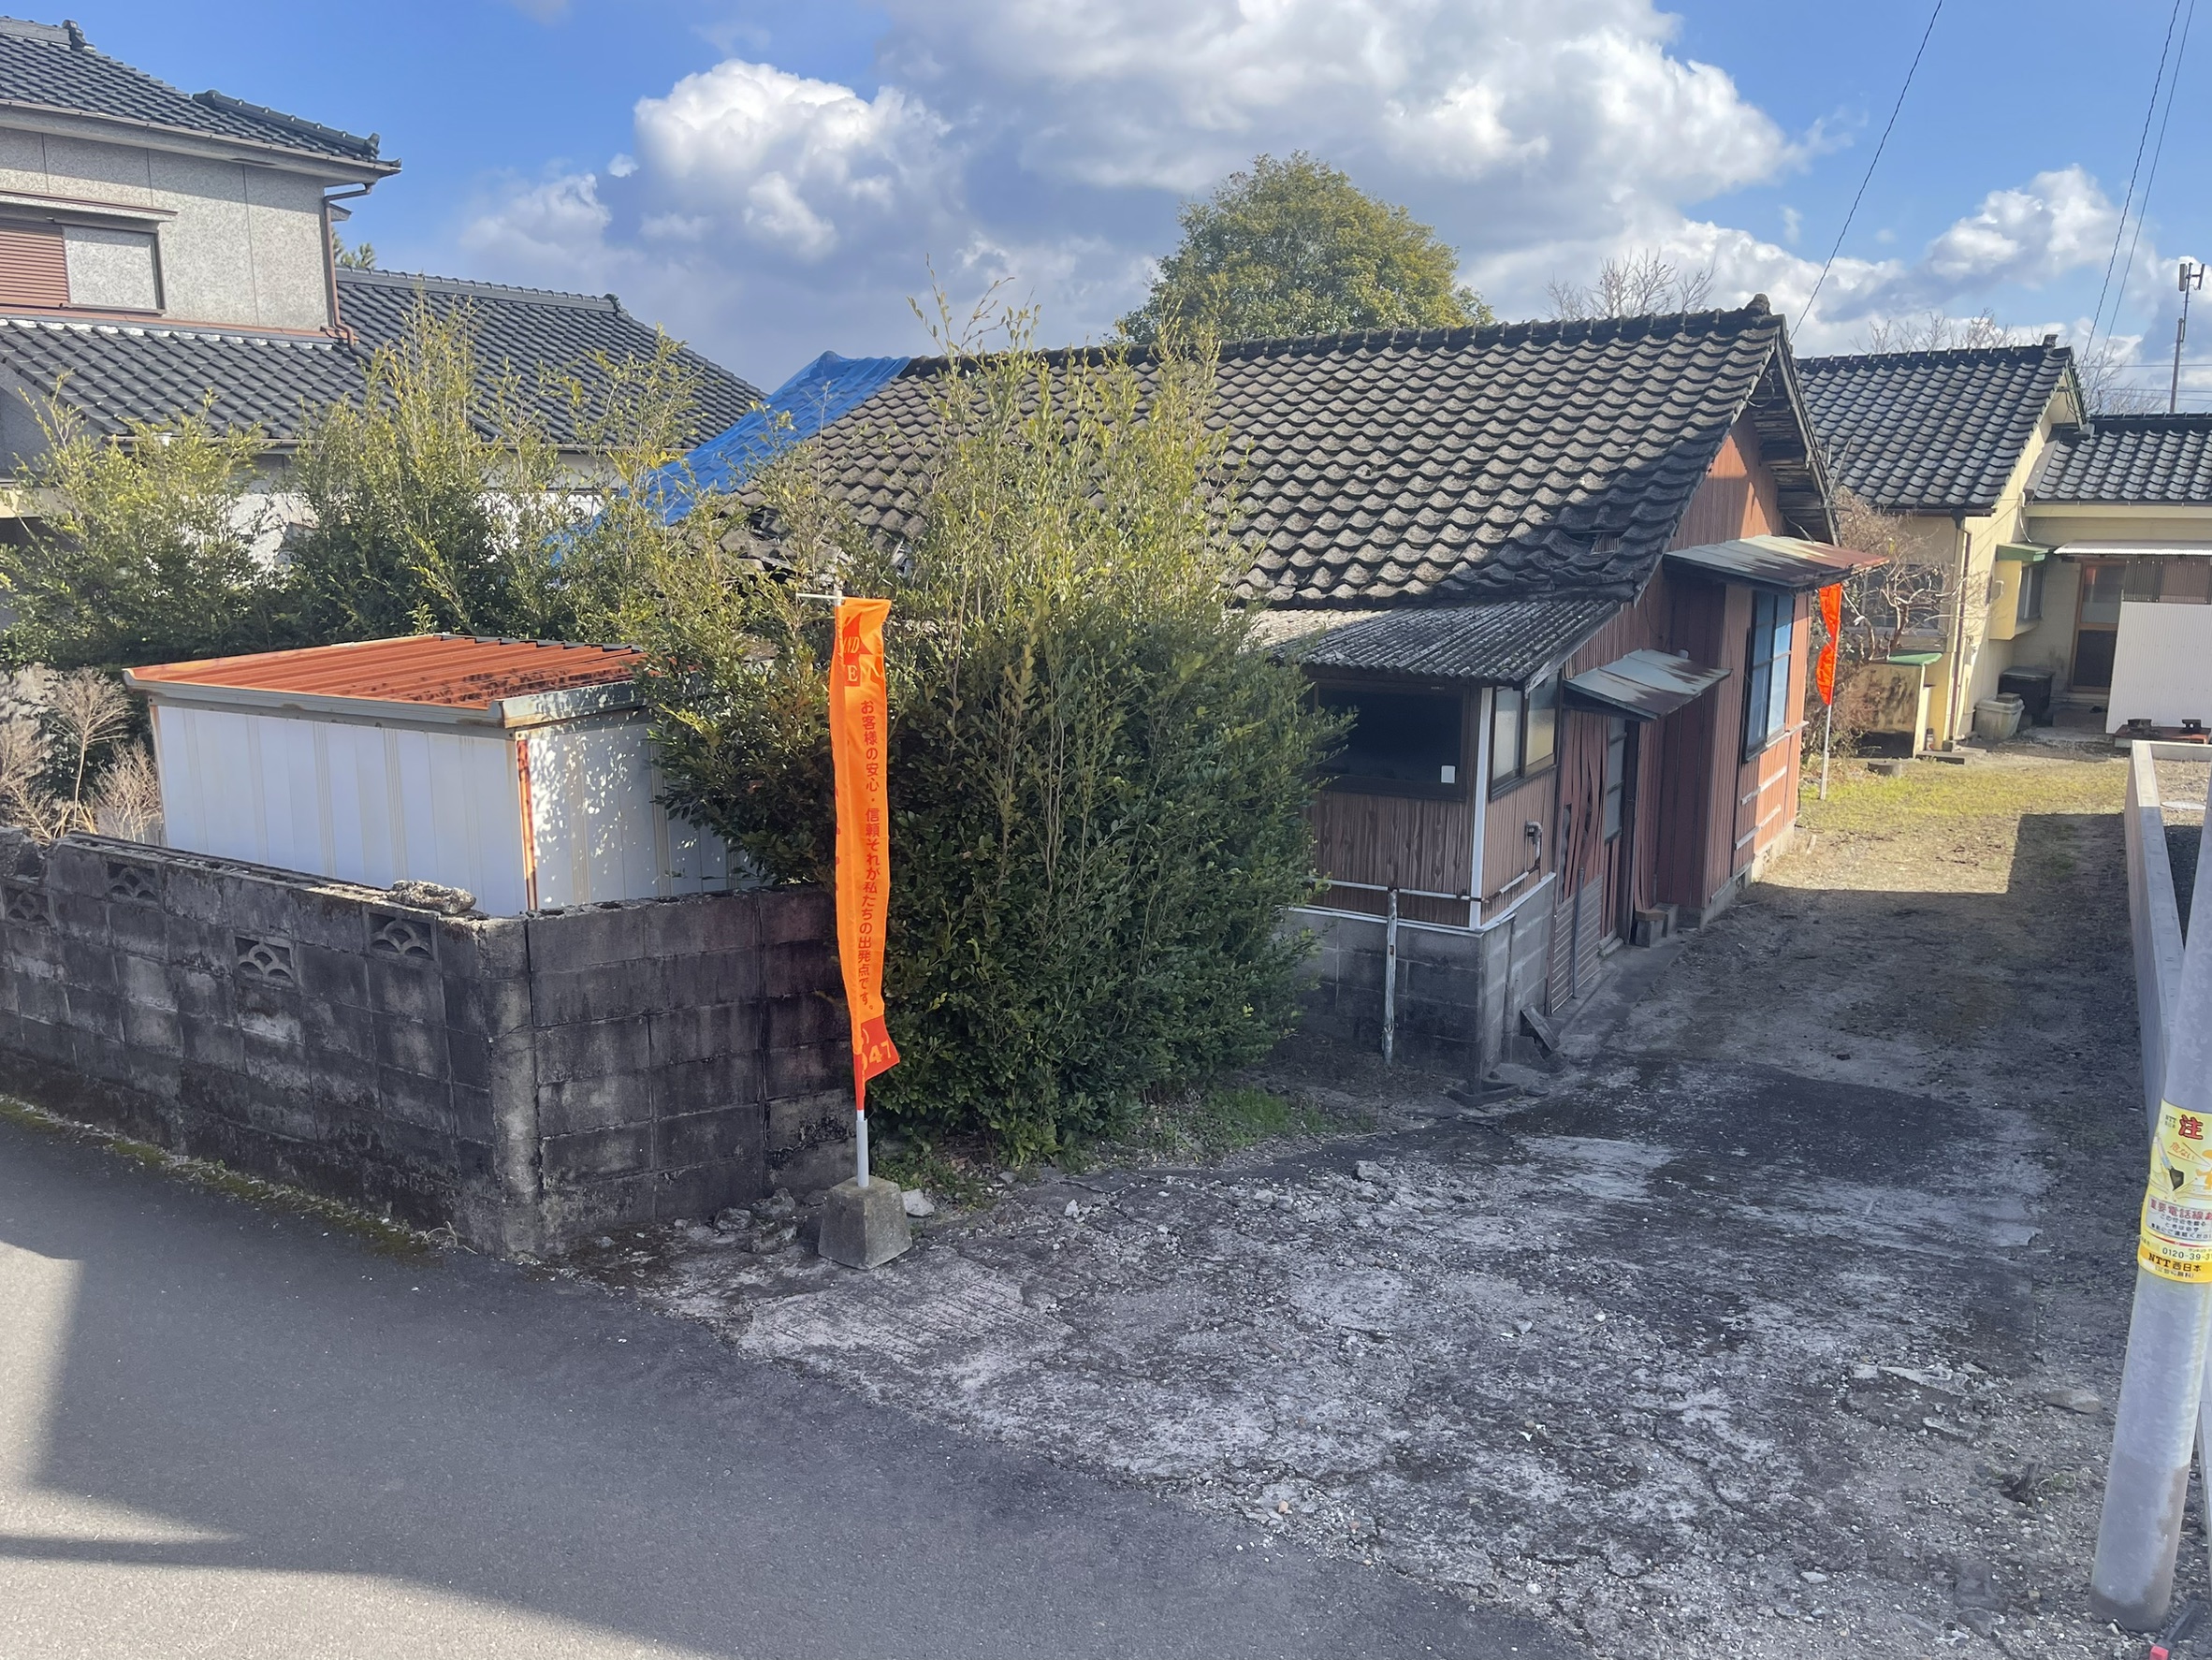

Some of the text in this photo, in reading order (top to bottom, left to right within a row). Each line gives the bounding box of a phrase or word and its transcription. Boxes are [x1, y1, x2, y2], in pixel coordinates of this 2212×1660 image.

[858, 700, 880, 1010] お客様の安心・信頼それが私たちの出発点です。
[2178, 1114, 2204, 1140] 注
